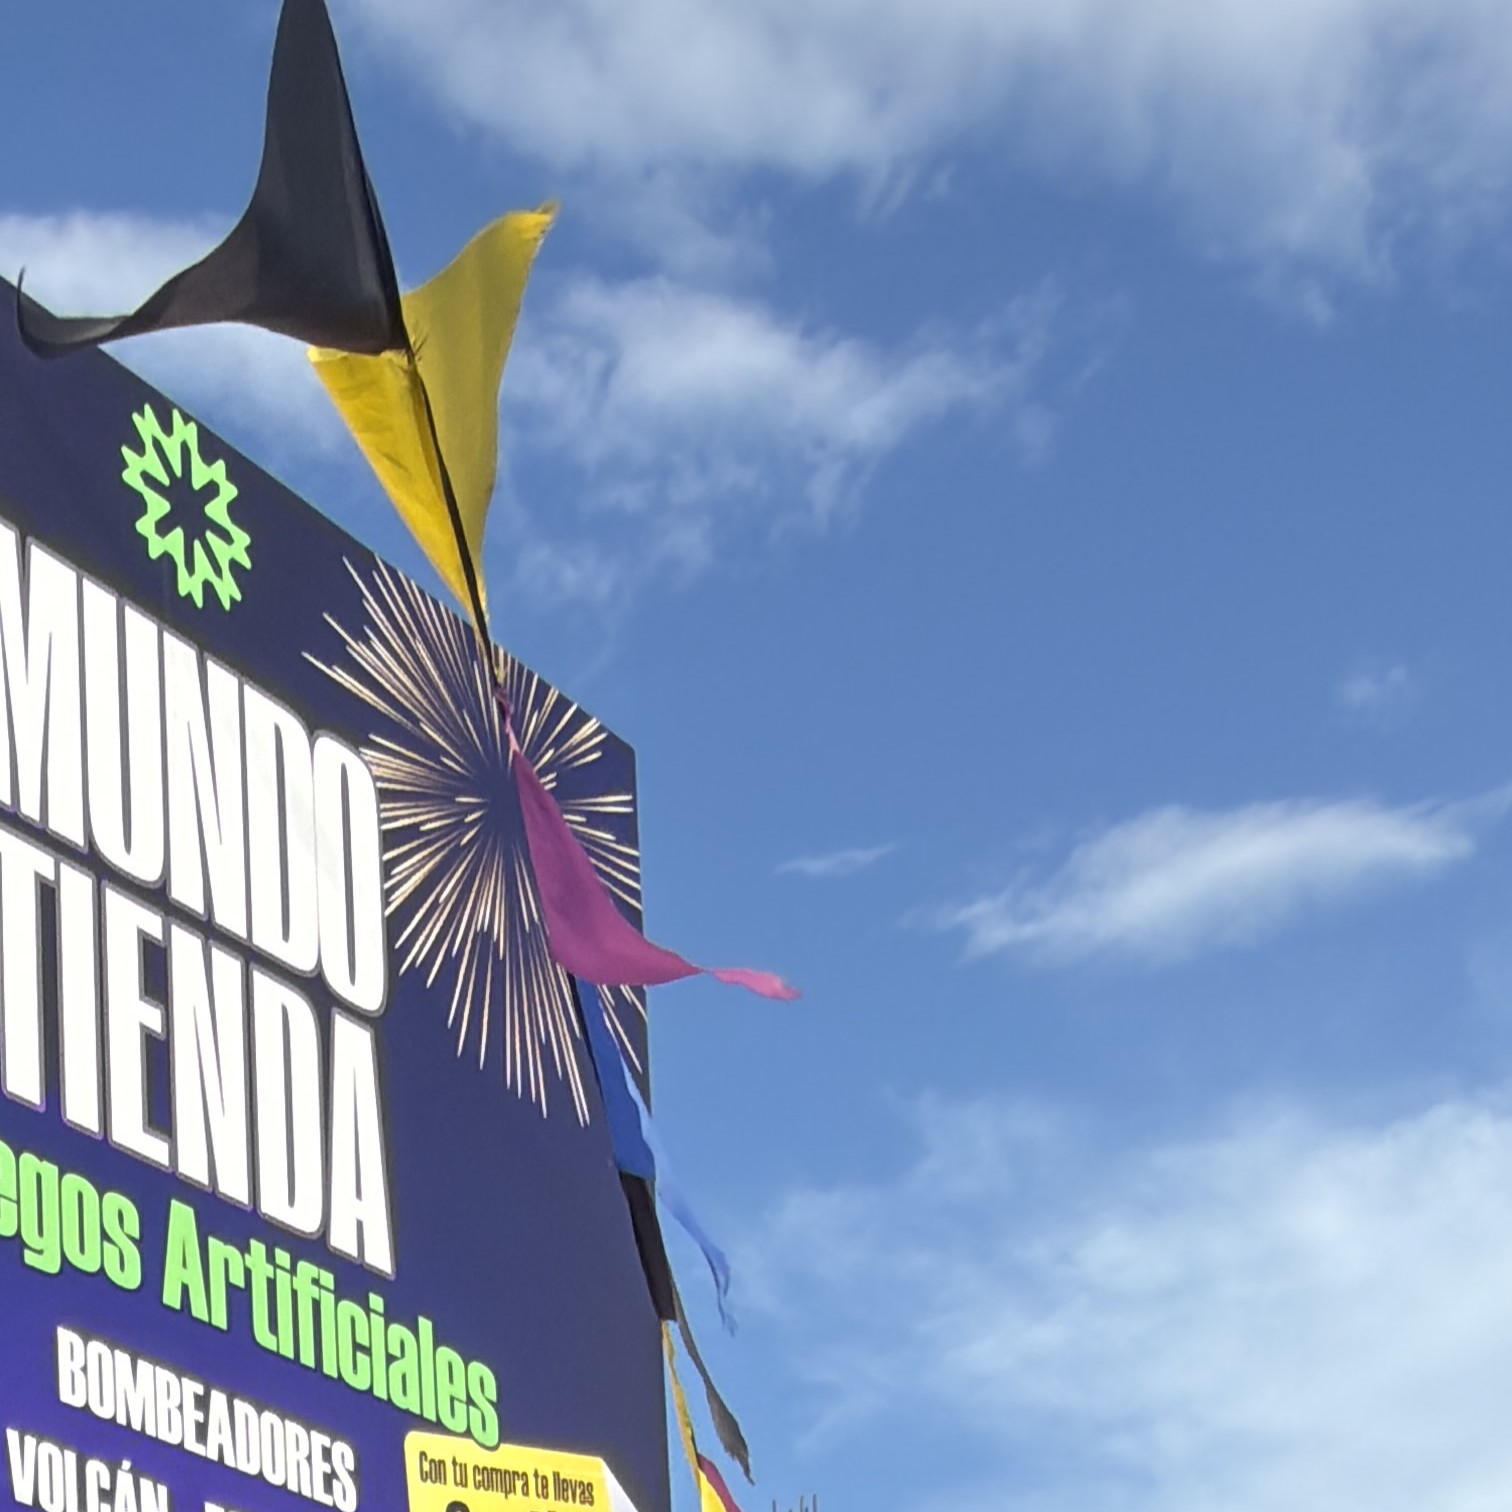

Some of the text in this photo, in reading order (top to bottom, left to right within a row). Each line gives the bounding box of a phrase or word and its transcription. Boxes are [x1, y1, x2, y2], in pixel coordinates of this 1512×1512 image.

[163, 1198, 500, 1448] Artificiales
[419, 1450, 595, 1507] Con tu compra te llevas
